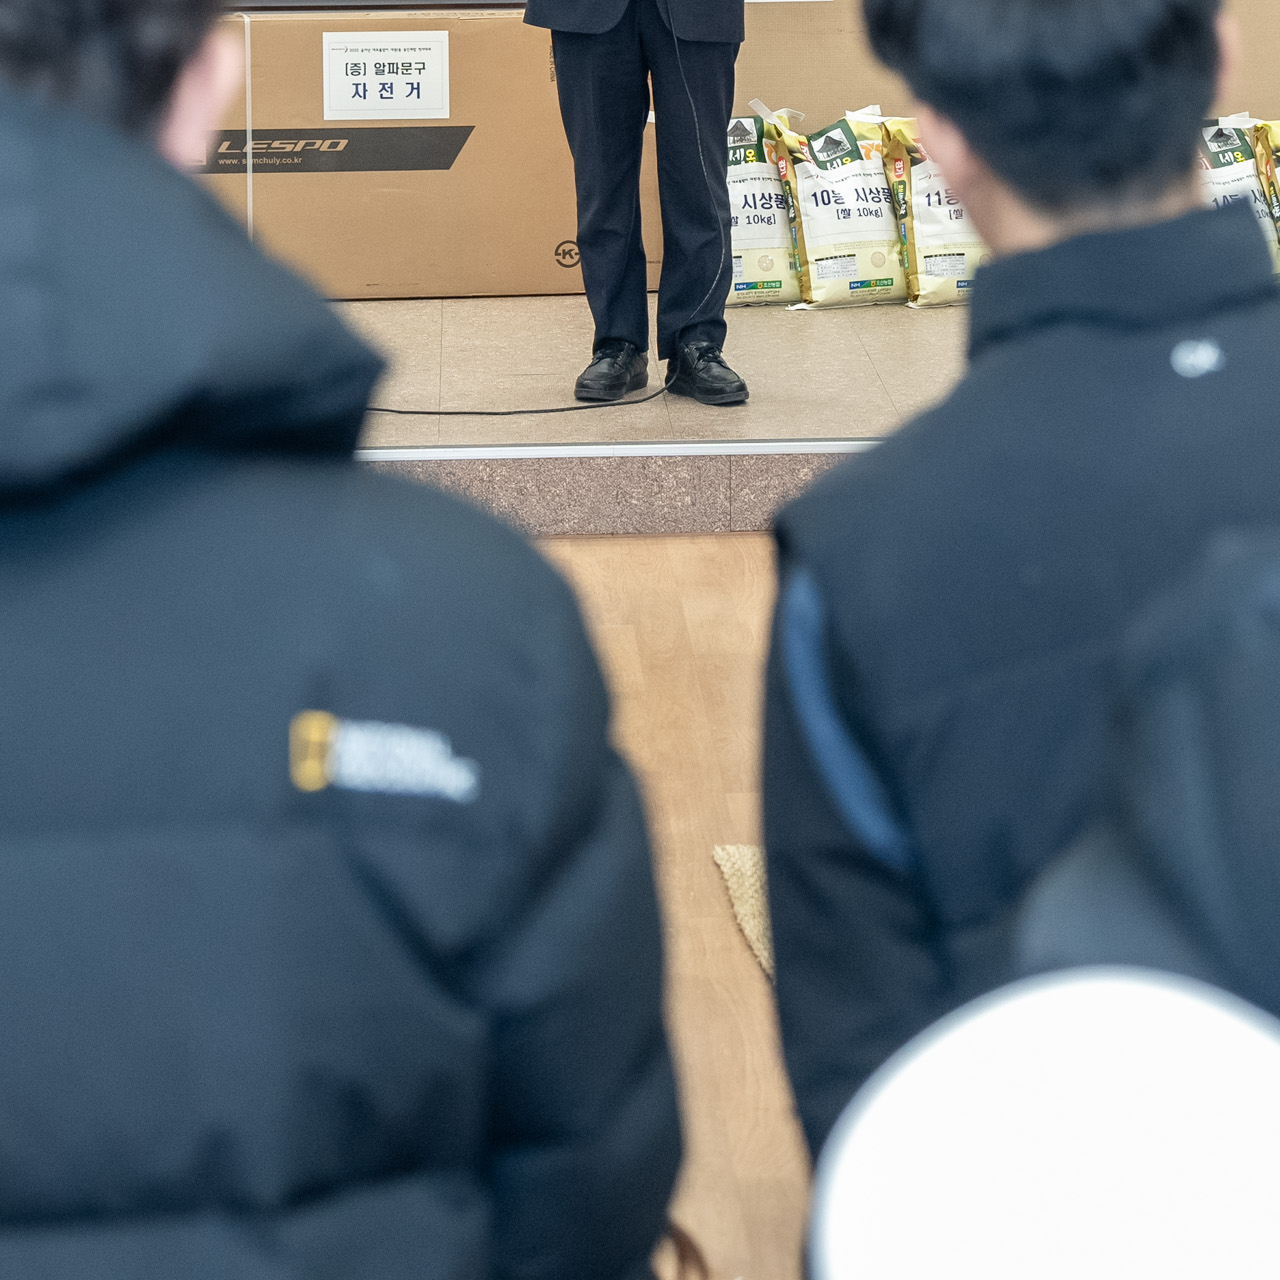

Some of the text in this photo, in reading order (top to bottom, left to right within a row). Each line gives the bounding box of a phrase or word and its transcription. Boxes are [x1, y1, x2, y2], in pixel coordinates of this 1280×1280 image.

[374, 61, 426, 76] 알파문구
[218, 139, 349, 153] LESPO
[242, 157, 302, 166] smchuly.co.kr
